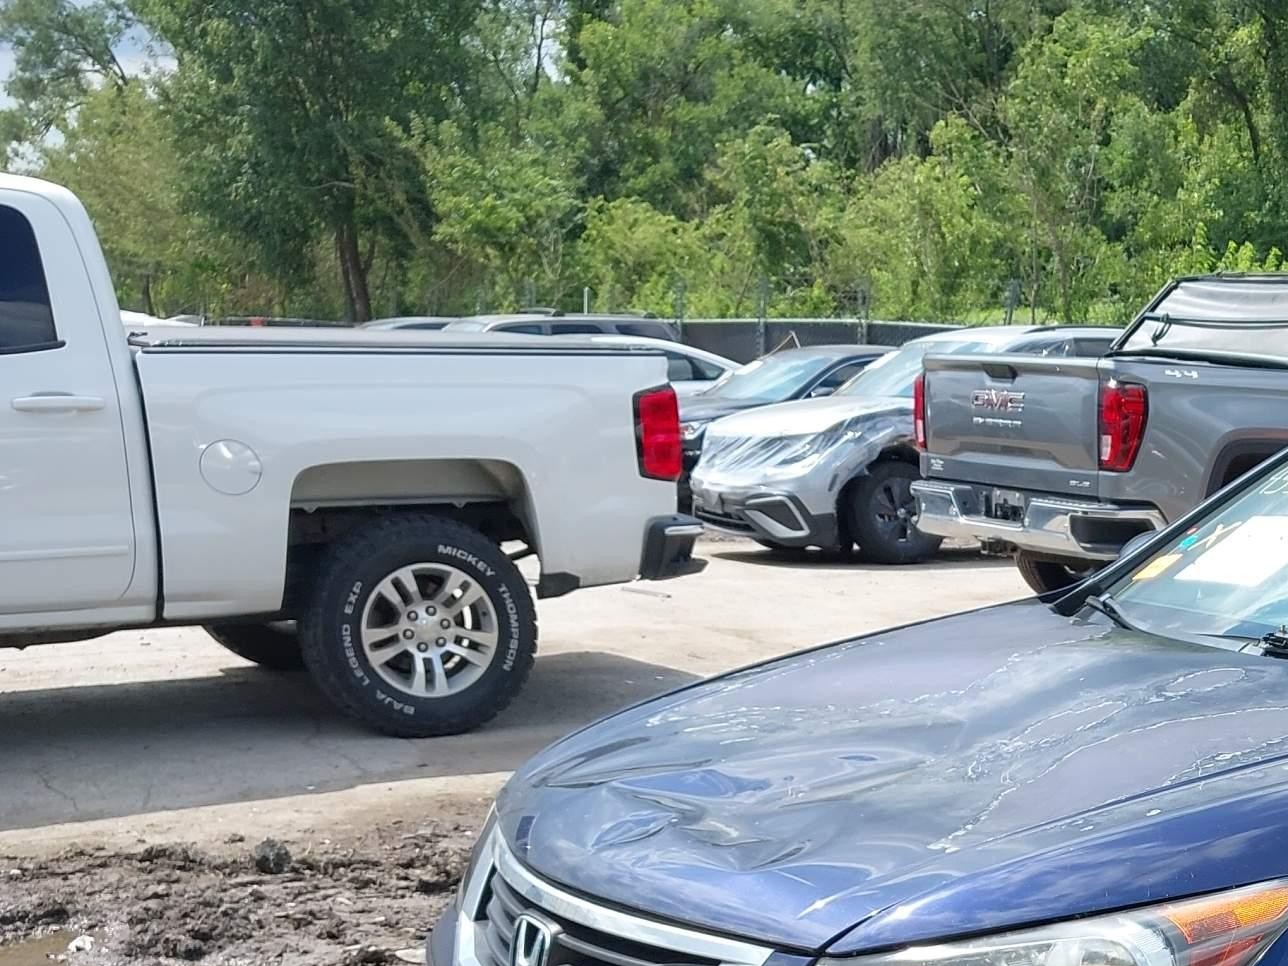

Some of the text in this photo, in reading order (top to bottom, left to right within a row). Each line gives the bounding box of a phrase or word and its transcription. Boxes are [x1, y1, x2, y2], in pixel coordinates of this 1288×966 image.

[970, 388, 1026, 412] GMC
[341, 580, 415, 715] BAJA LEGEND EXP
[437, 544, 520, 672] MICKEY THOMPSON
